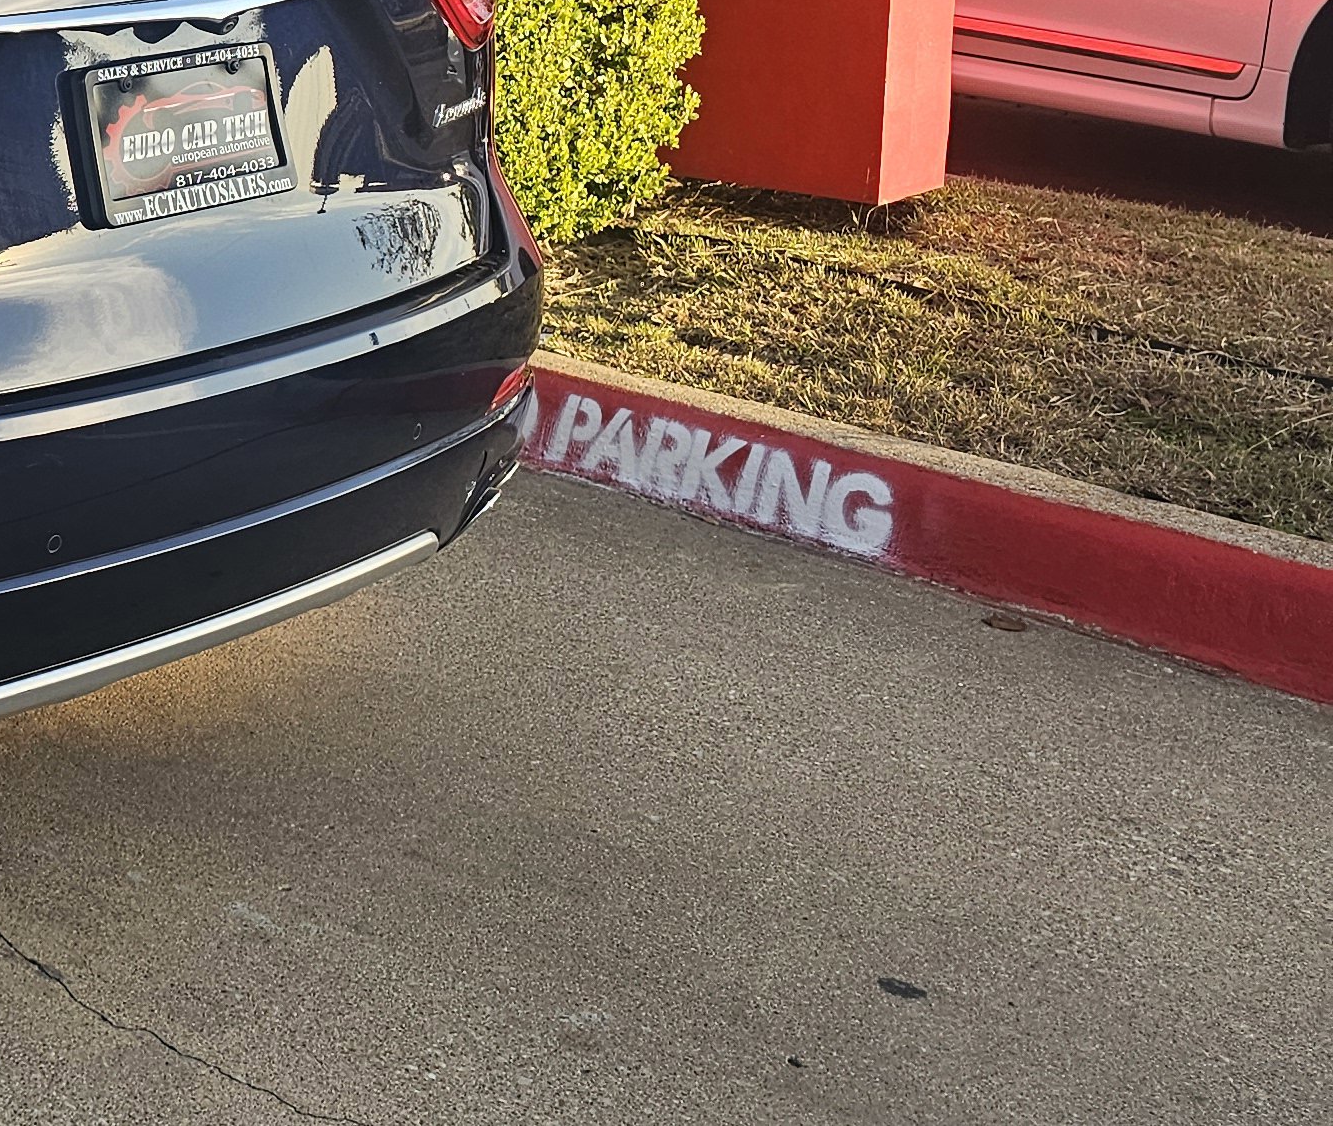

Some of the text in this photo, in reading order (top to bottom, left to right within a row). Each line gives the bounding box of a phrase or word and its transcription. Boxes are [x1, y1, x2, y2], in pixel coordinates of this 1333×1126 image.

[97, 44, 260, 82] SALES & SERVICE 817-404-4033
[122, 109, 268, 163] EURO CAR TECH
[171, 136, 271, 165] european automotive
[175, 156, 275, 187] 817-404-4033
[114, 173, 293, 225] www.ECTAUTOSALES.com
[545, 393, 895, 558] PARKING
